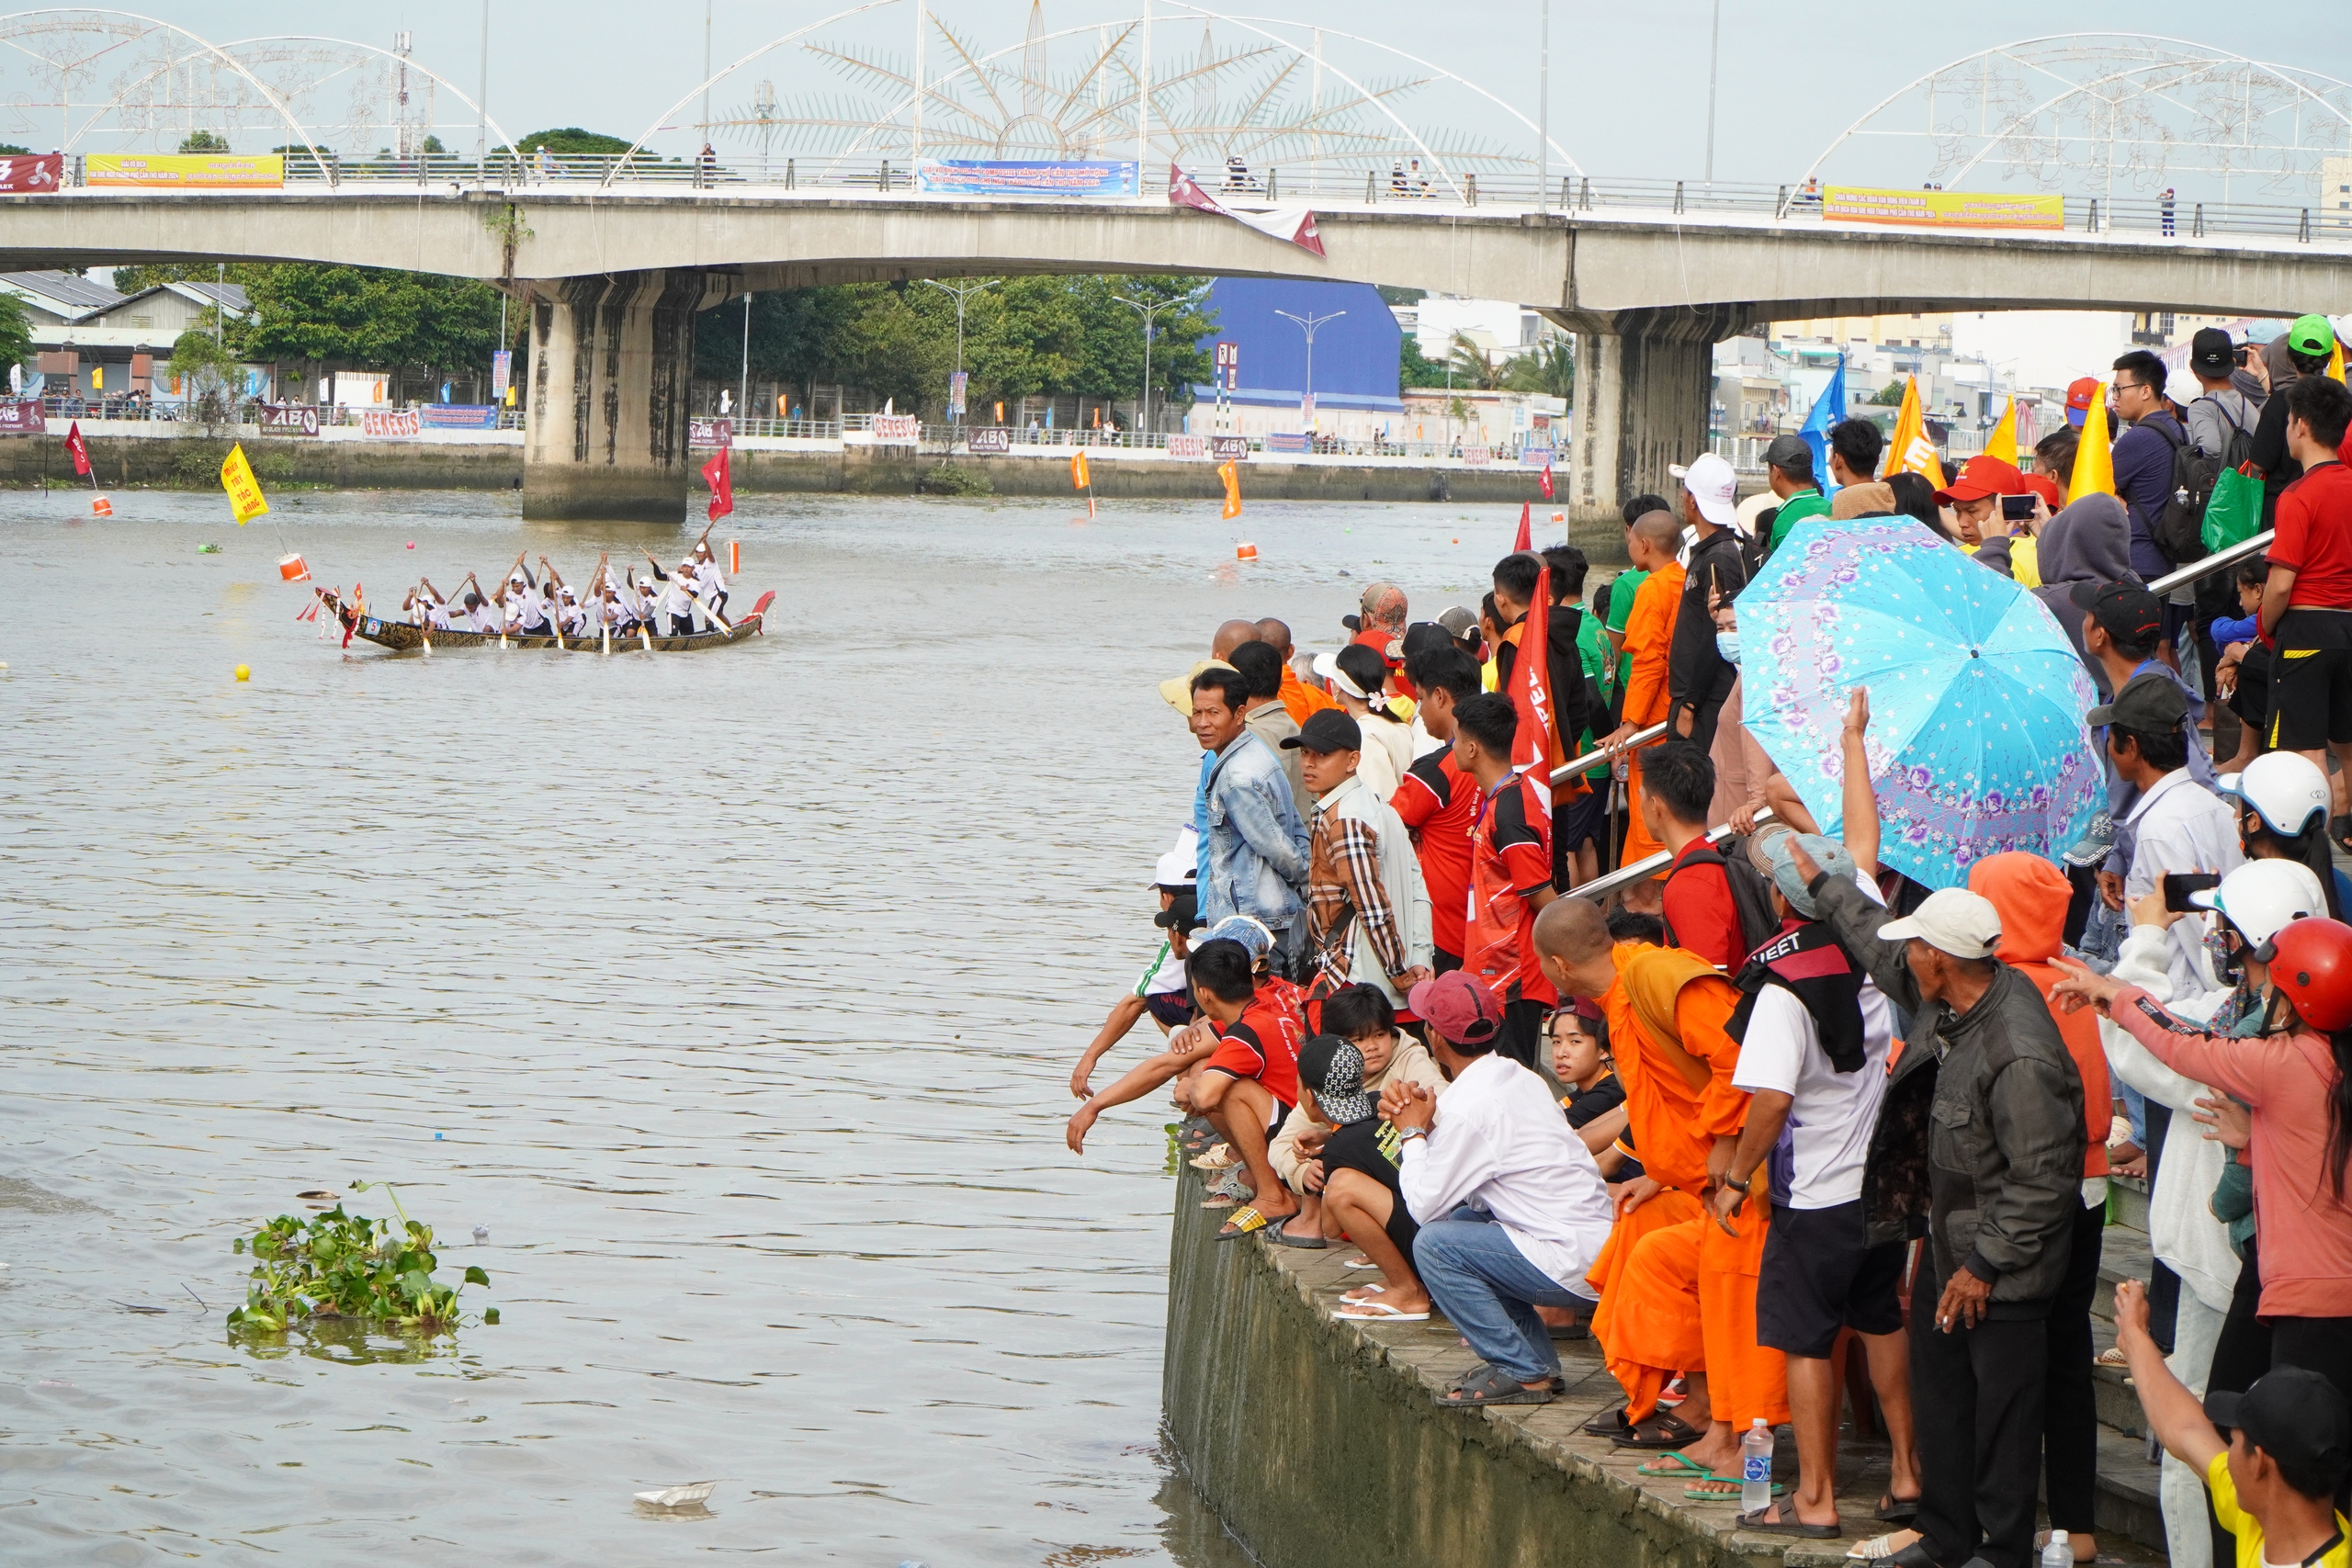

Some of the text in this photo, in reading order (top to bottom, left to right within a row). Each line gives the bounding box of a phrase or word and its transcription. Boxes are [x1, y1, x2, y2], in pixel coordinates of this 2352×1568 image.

[922, 165, 933, 174] GIẢI
[981, 168, 1016, 176] COMPOSITE
[1016, 167, 1037, 176] THÀNH
[1037, 166, 1050, 177] PHỐ
[1051, 167, 1065, 176] CẦN
[1065, 168, 1078, 176] THƠ
[1090, 168, 1109, 178] RỘNG
[929, 175, 941, 184] GIẢI
[1006, 177, 1026, 186] THÀNH
[1027, 175, 1041, 186] PHỐ
[1041, 176, 1054, 186] CẦN
[1055, 178, 1068, 186] THƠ
[1068, 177, 1084, 186] NĂM
[1084, 179, 1101, 187] 2024
[271, 410, 302, 425] AB
[364, 412, 419, 436] GENESIS
[875, 416, 917, 438] GENESIS
[977, 430, 998, 444] AB
[1169, 437, 1204, 457] GENESIS
[1464, 447, 1490, 467] GENESIS
[370, 621, 377, 632] 5
